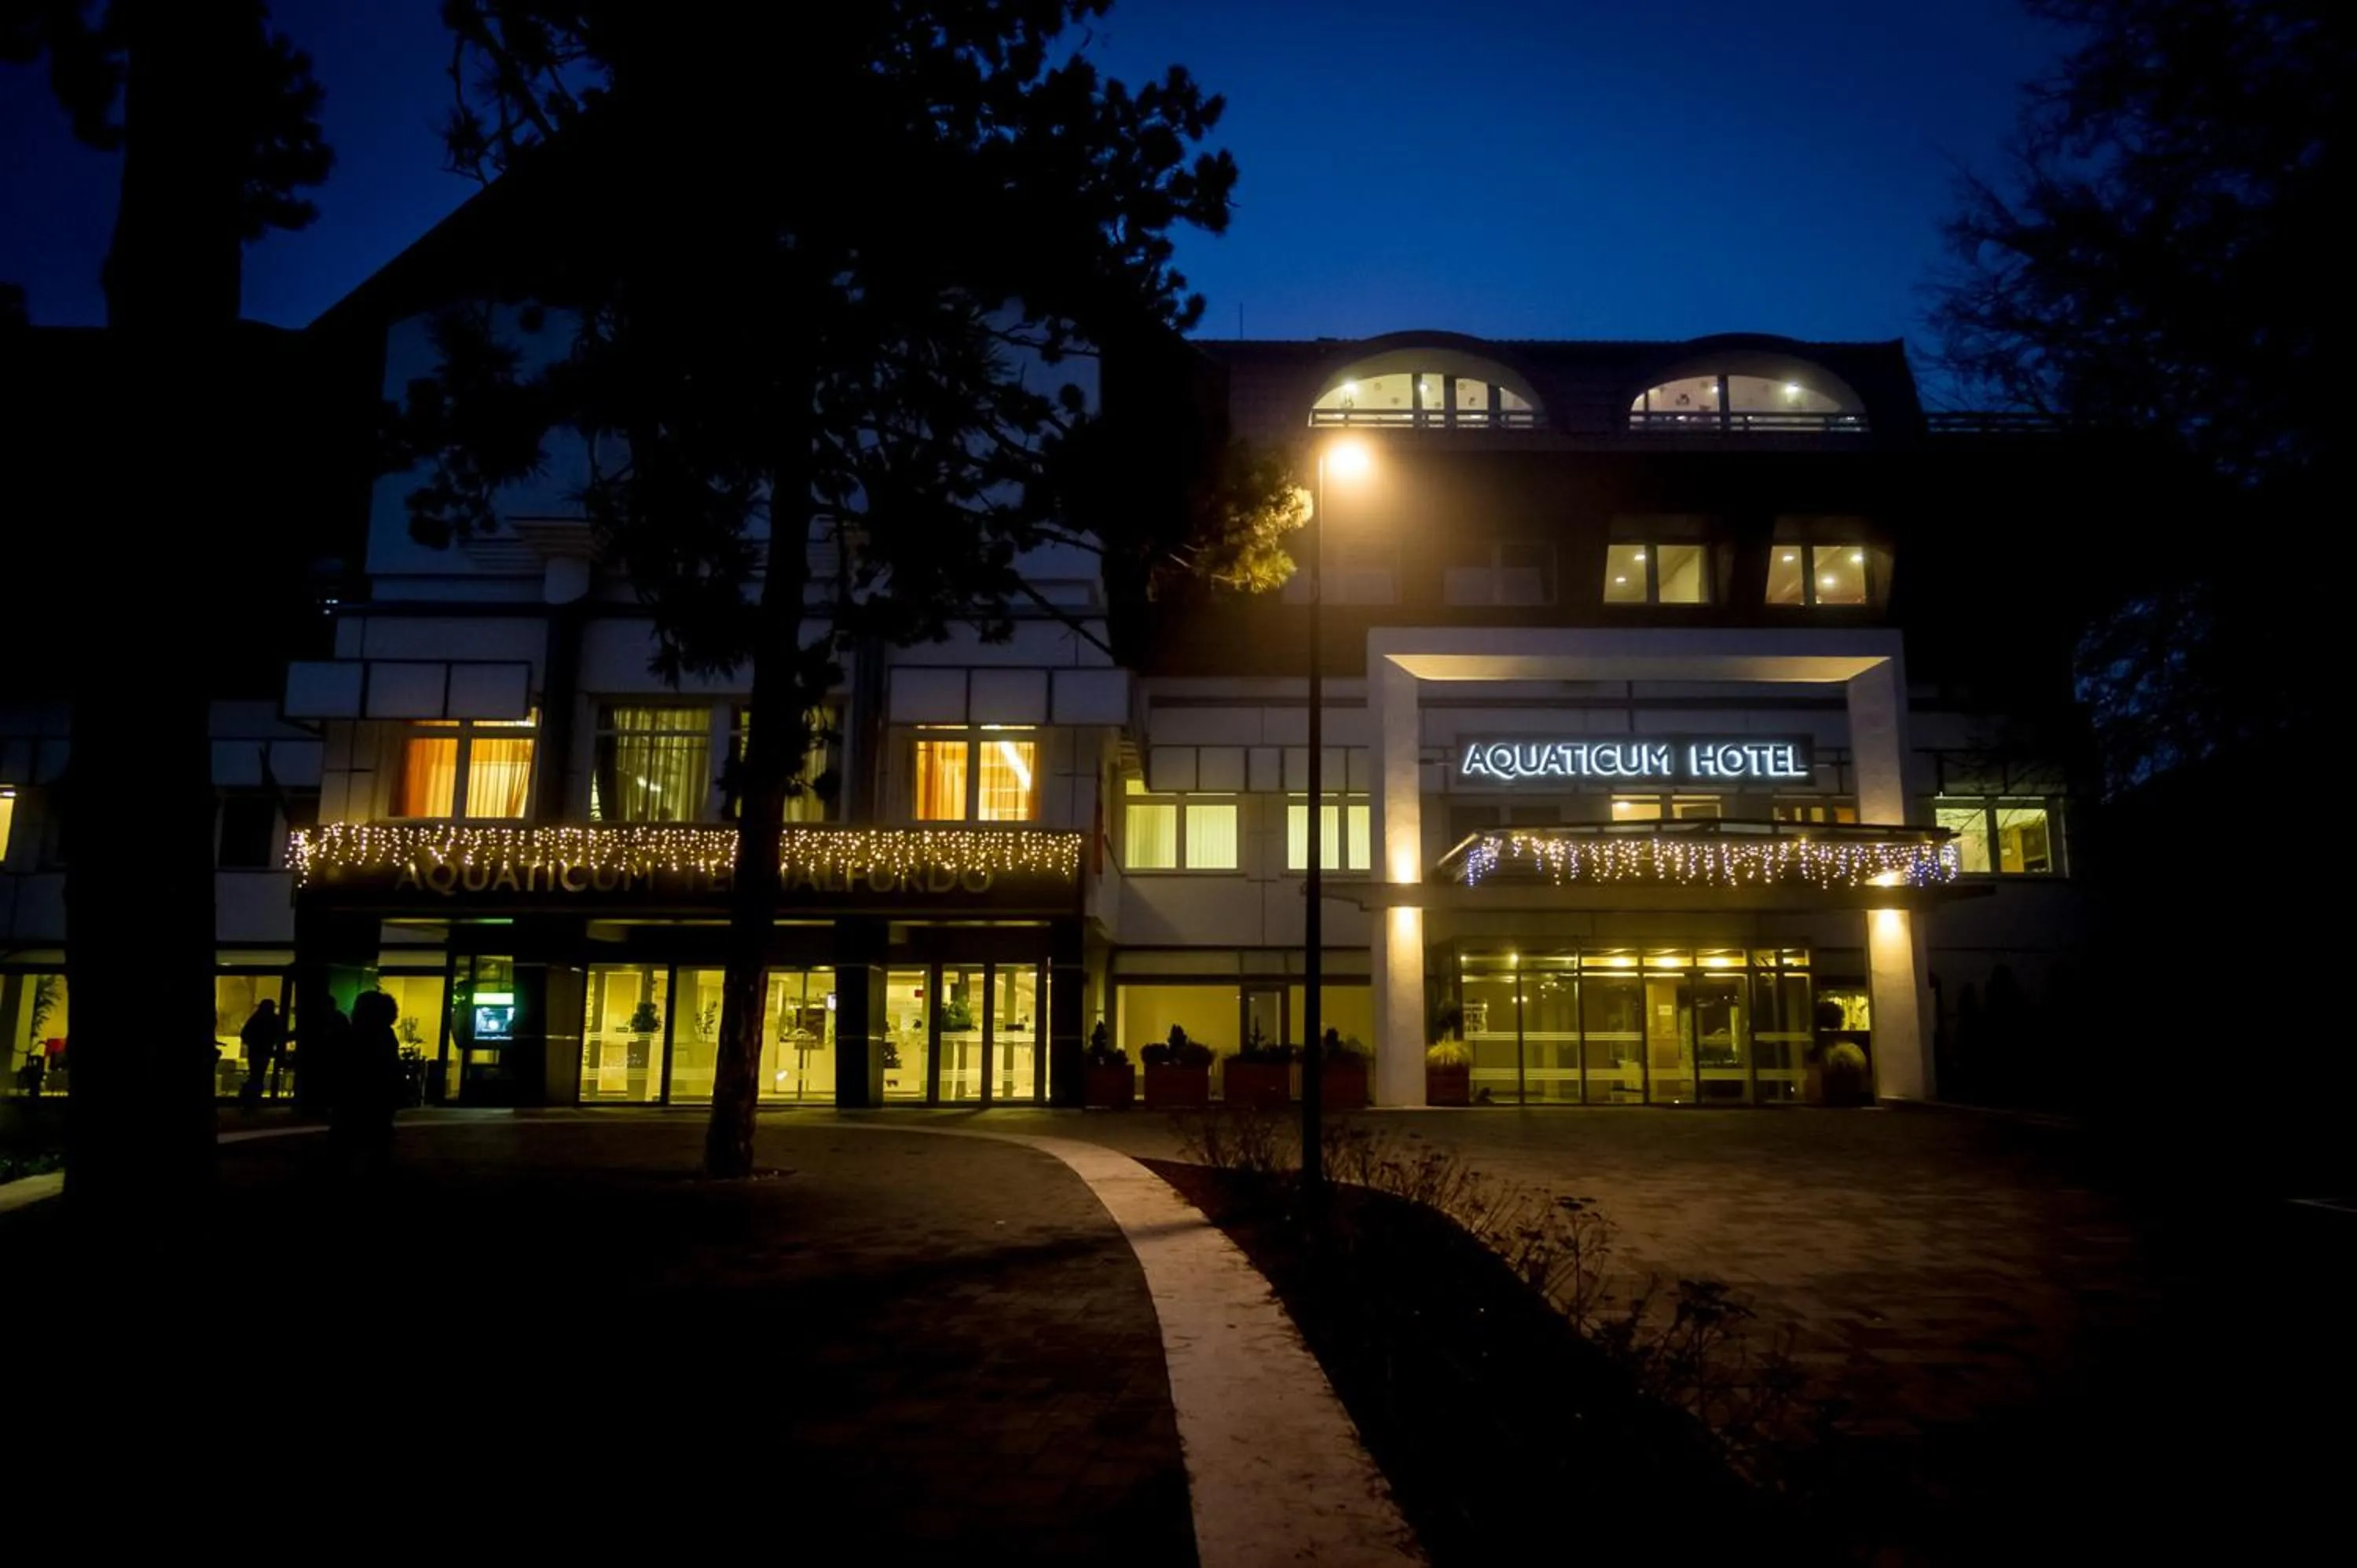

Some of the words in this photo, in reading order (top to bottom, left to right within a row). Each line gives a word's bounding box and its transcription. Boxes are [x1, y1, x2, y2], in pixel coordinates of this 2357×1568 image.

[1462, 743, 1672, 779] AQUATICUM
[1690, 743, 1809, 776] HOTEL
[394, 859, 654, 896] AQUATICUM
